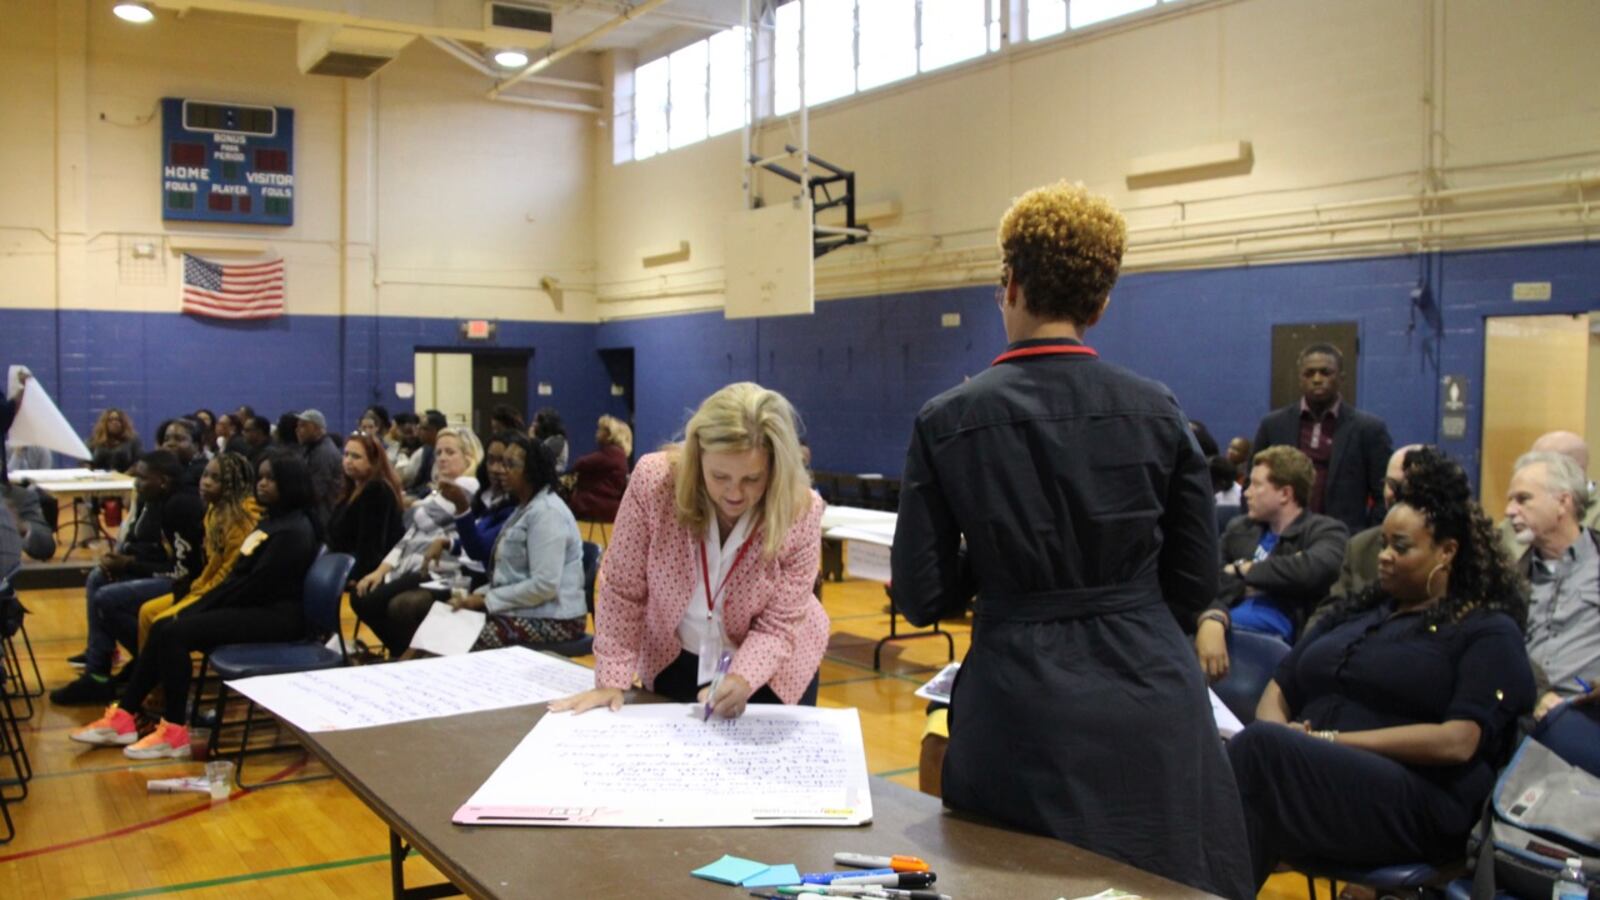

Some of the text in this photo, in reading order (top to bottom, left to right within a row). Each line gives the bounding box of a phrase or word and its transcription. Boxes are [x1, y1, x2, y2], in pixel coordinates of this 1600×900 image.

[165, 166, 209, 180] HOME
[246, 172, 293, 185] VISITOR
[165, 181, 198, 193] FOULS
[211, 183, 248, 195] PLAYER
[261, 186, 292, 198] FOULS
